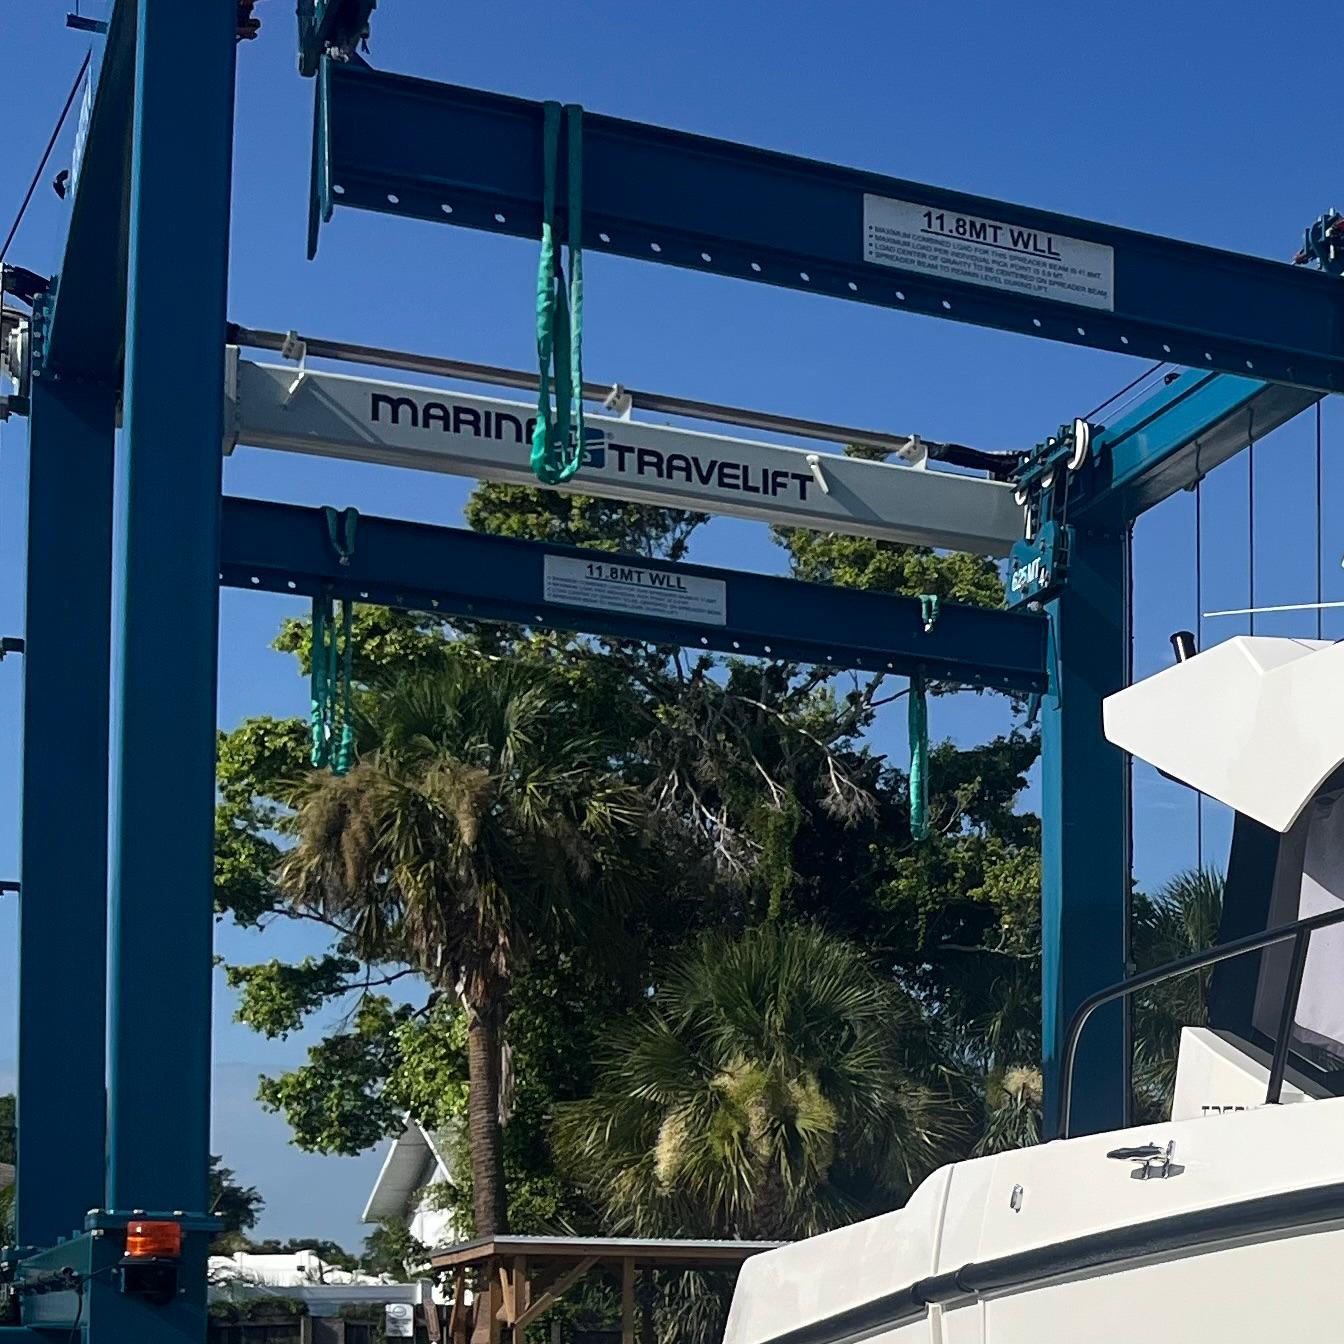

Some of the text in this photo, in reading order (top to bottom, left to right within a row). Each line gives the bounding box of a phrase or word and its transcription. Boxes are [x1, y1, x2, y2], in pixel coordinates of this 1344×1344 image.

[923, 211, 1061, 255] 11.8MT WLL
[607, 444, 814, 501] TRAVELIFT
[648, 570, 688, 592] WLL
